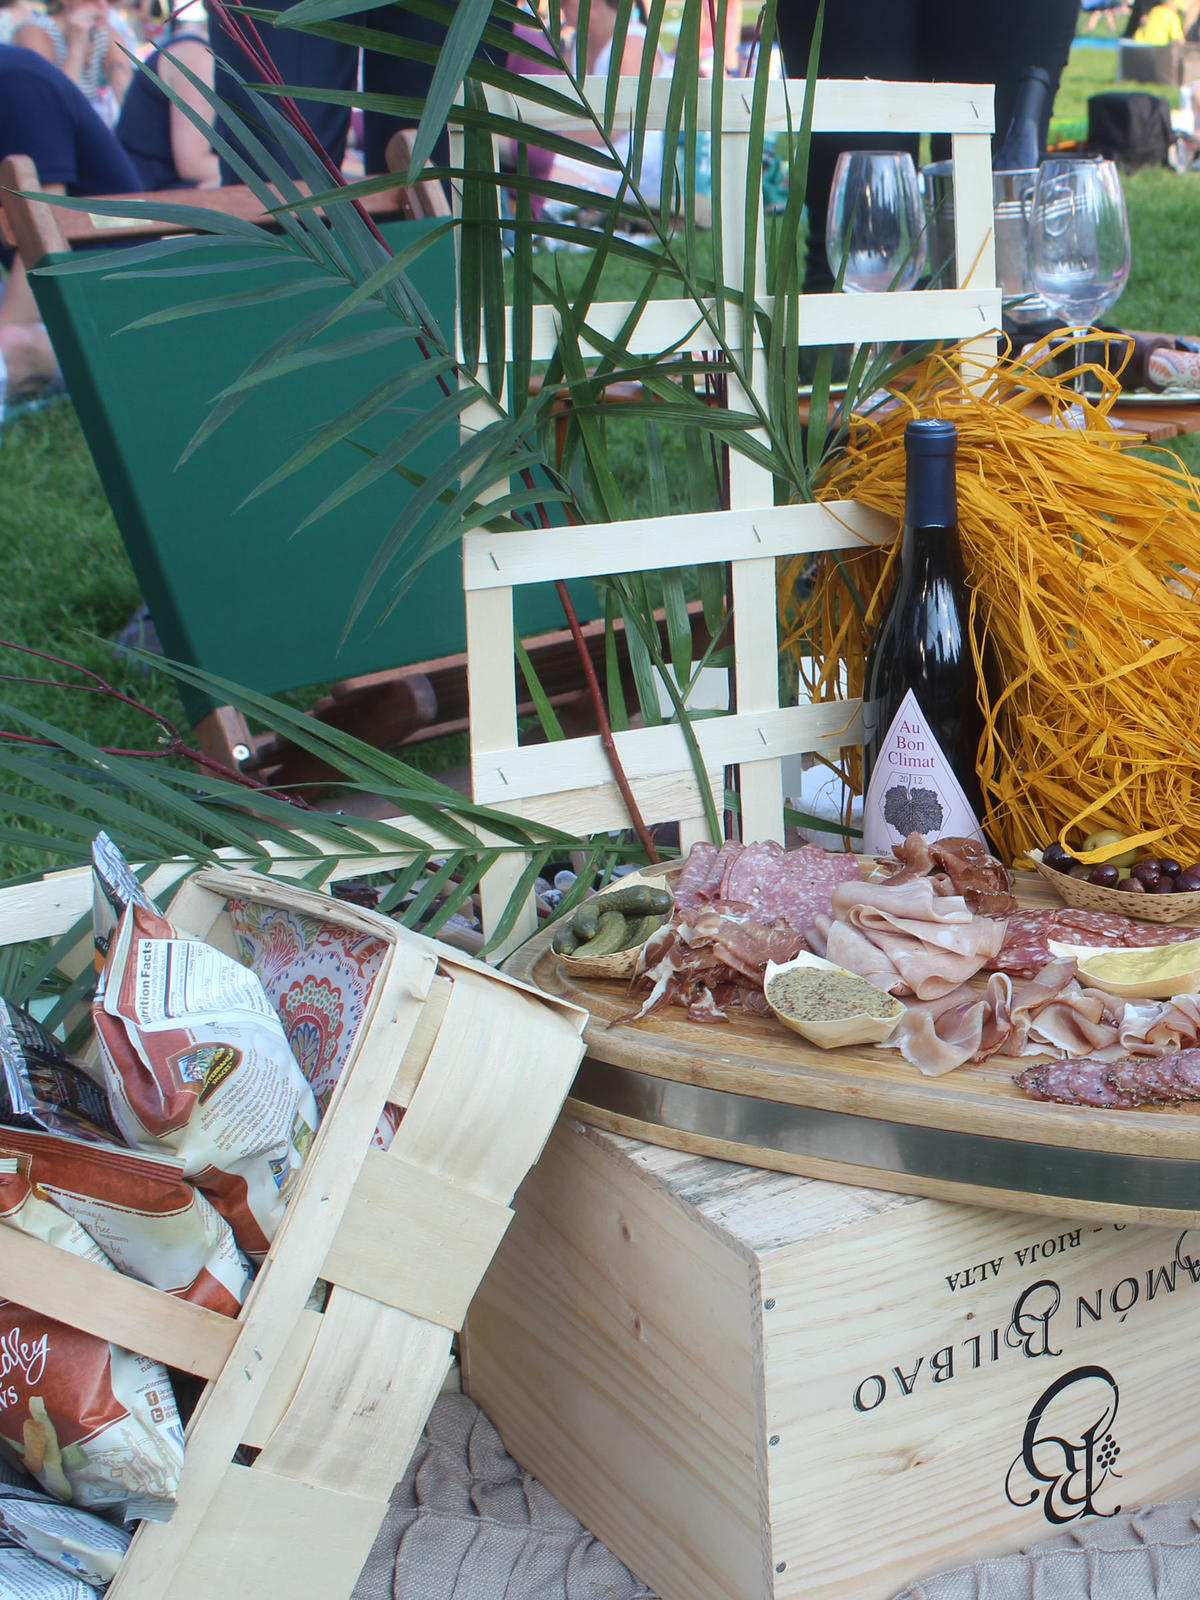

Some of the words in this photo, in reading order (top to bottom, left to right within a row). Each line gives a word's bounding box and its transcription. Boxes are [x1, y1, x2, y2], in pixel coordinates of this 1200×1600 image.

[896, 735, 926, 751] Bon
[899, 720, 921, 734] Au
[888, 751, 936, 768] Climat
[141, 941, 152, 978] Facts
[1015, 1228, 1082, 1268] RIOJA
[944, 1255, 1005, 1294] ALTA
[0, 1327, 51, 1385] dley
[852, 1278, 1064, 1413] BILBAO
